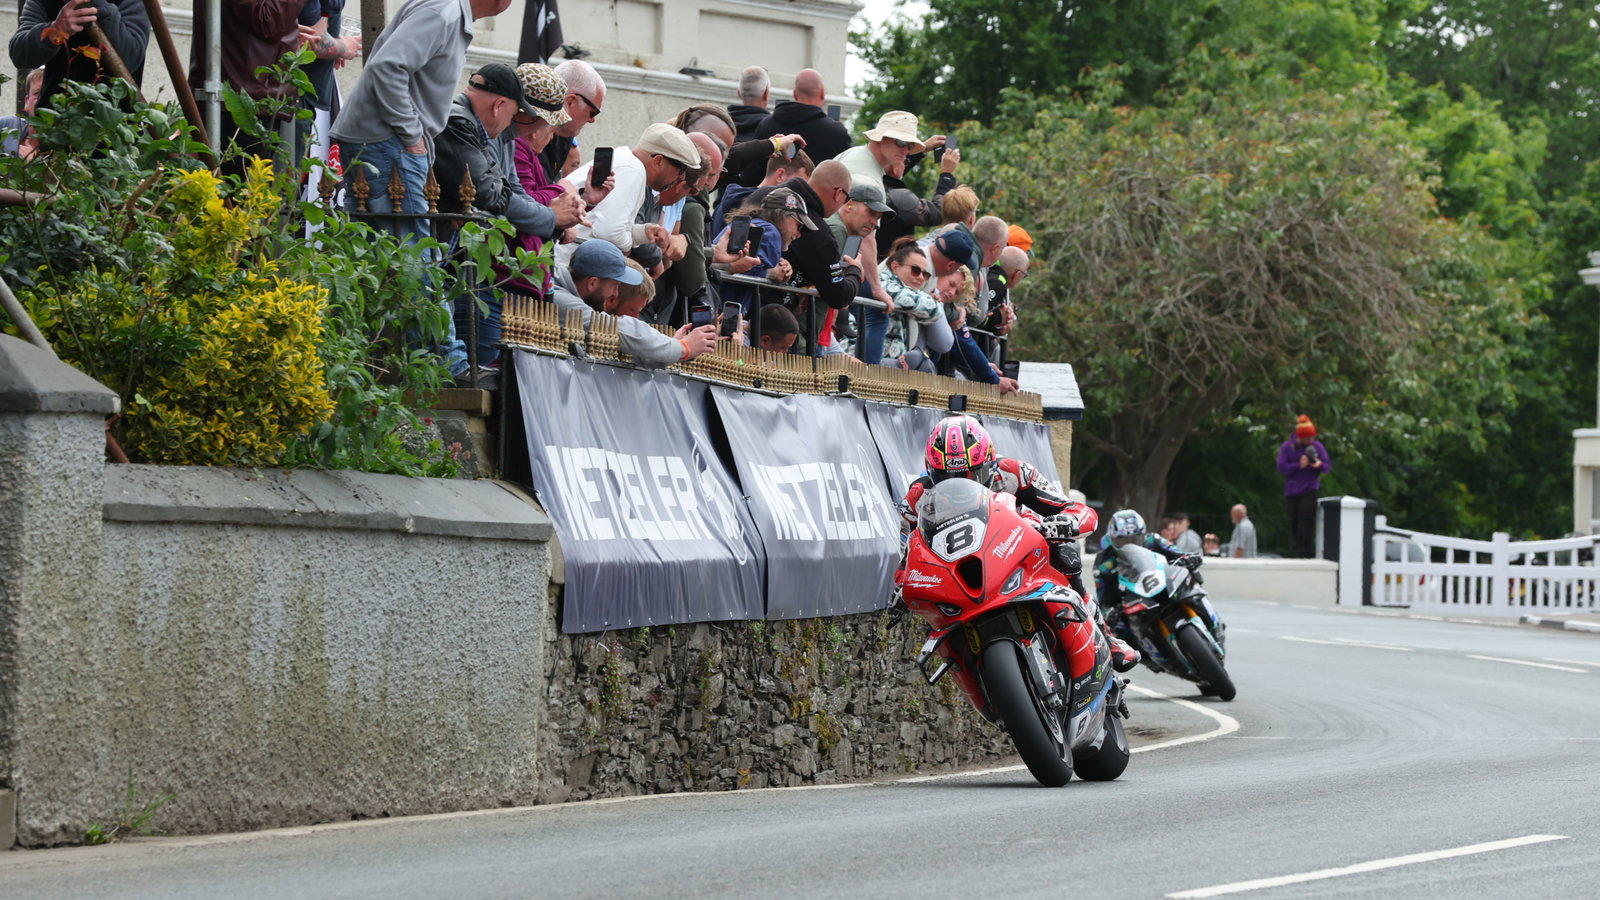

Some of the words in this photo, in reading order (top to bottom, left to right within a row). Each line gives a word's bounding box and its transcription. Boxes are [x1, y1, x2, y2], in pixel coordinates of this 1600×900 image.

[945, 457, 967, 467] Arai
[545, 445, 714, 540] METZELER
[749, 461, 886, 541] METZELER
[946, 524, 974, 555] 8
[992, 525, 1023, 559] Milwaukee
[908, 569, 943, 583] Milwaukee
[1142, 574, 1160, 594] 6
